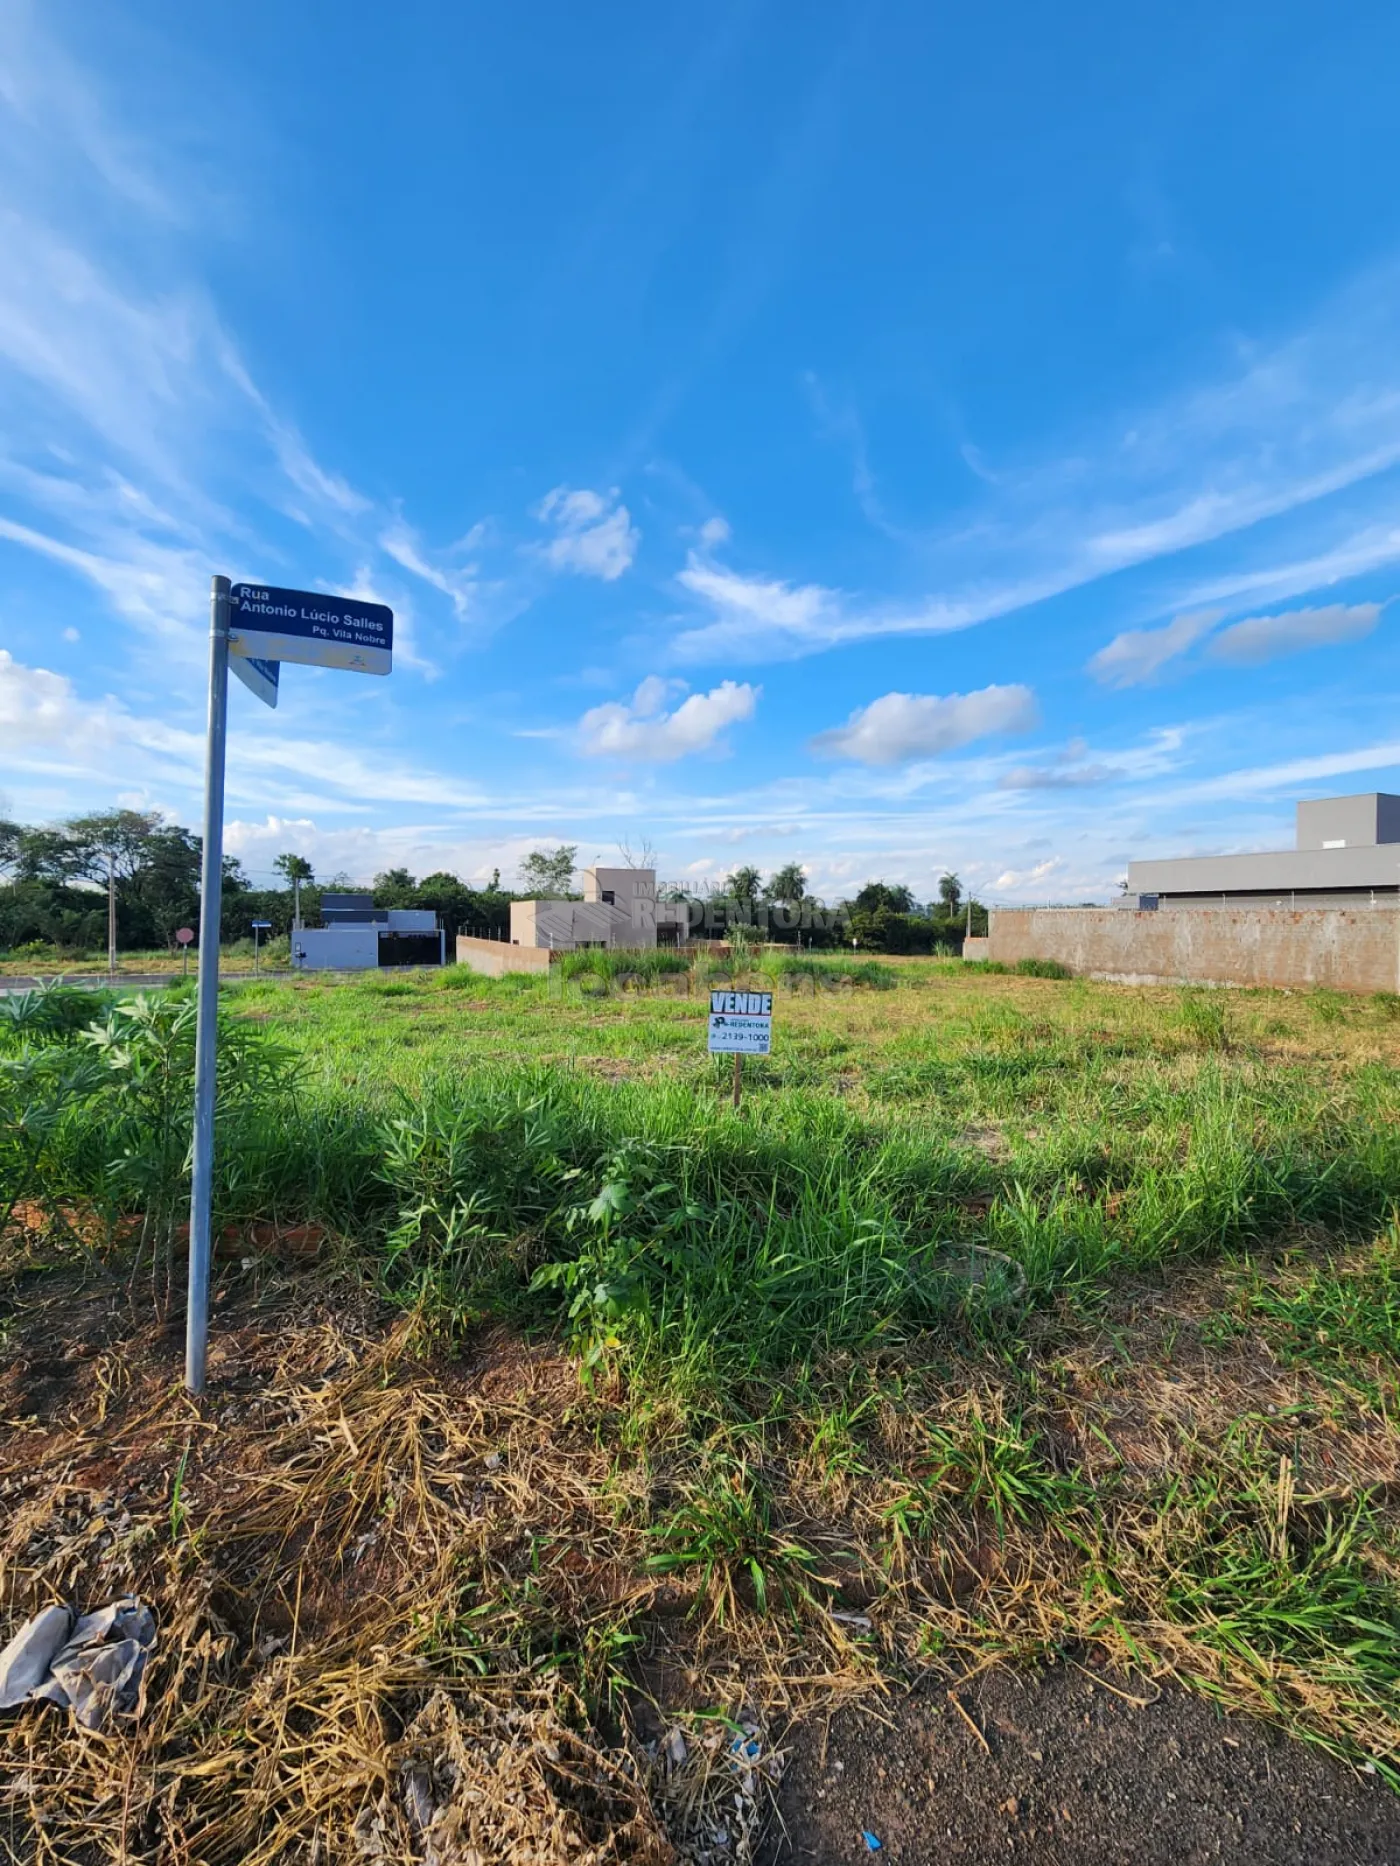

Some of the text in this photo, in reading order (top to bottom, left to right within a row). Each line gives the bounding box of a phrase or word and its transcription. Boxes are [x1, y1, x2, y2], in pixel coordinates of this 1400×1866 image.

[240, 586, 270, 601] Rua
[240, 601, 384, 632] Antonio Lúcio Salles
[312, 625, 386, 645] Pq. Vila Nobre
[711, 992, 772, 1014] VENDE
[722, 1032, 770, 1041] 2139-1000
